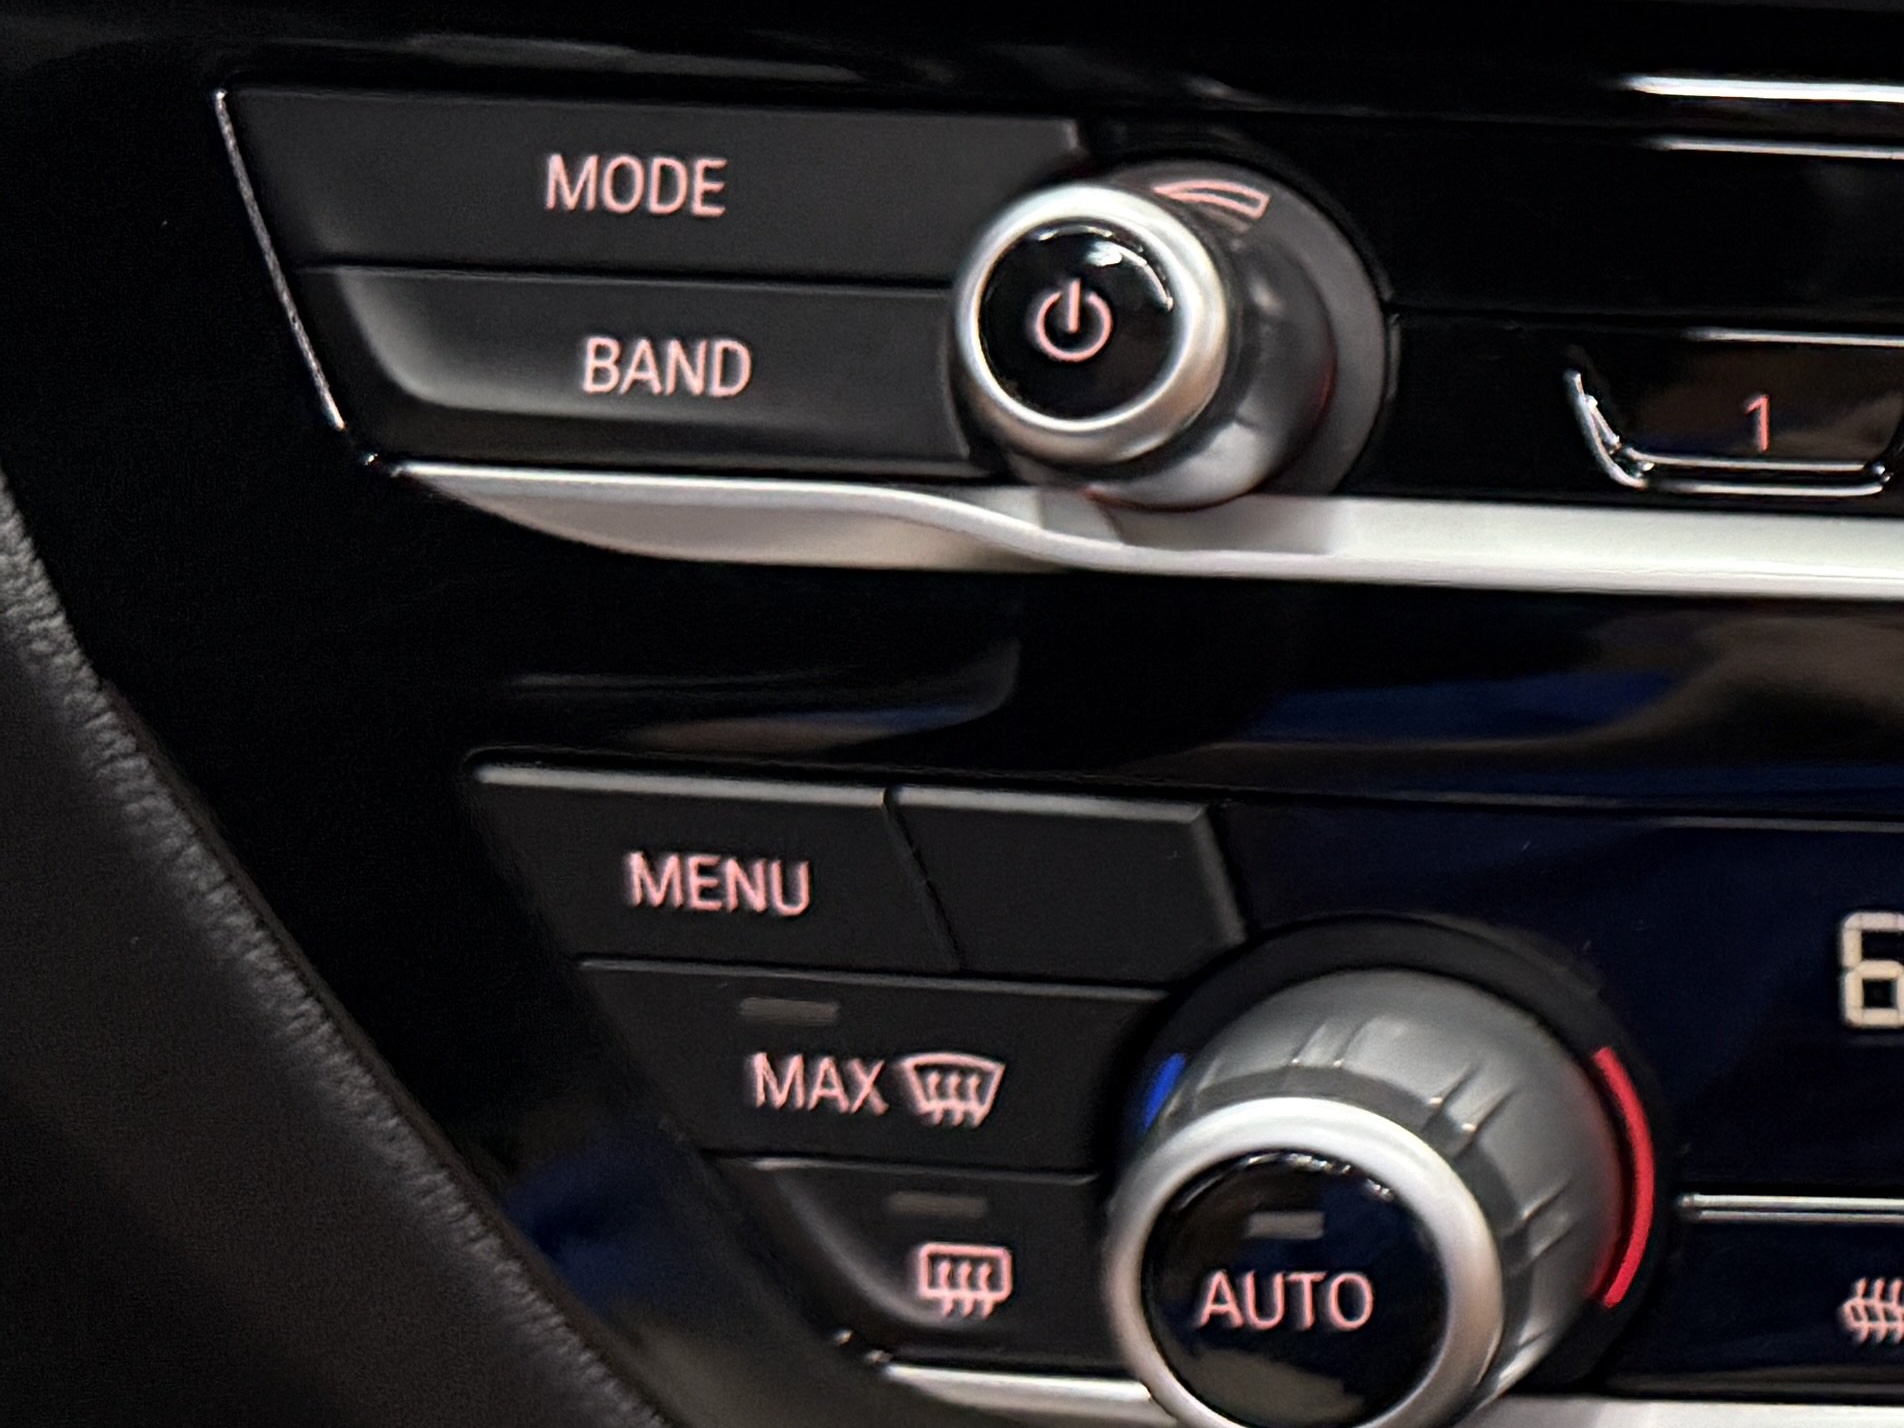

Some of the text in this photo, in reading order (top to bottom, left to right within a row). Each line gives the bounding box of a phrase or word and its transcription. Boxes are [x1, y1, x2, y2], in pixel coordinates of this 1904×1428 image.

[546, 154, 727, 217] MODE
[581, 336, 752, 398] BAND
[1746, 395, 1770, 451] 1
[626, 852, 811, 917] MENU
[751, 1052, 889, 1114] MAX
[1198, 1271, 1375, 1331] AUTO
